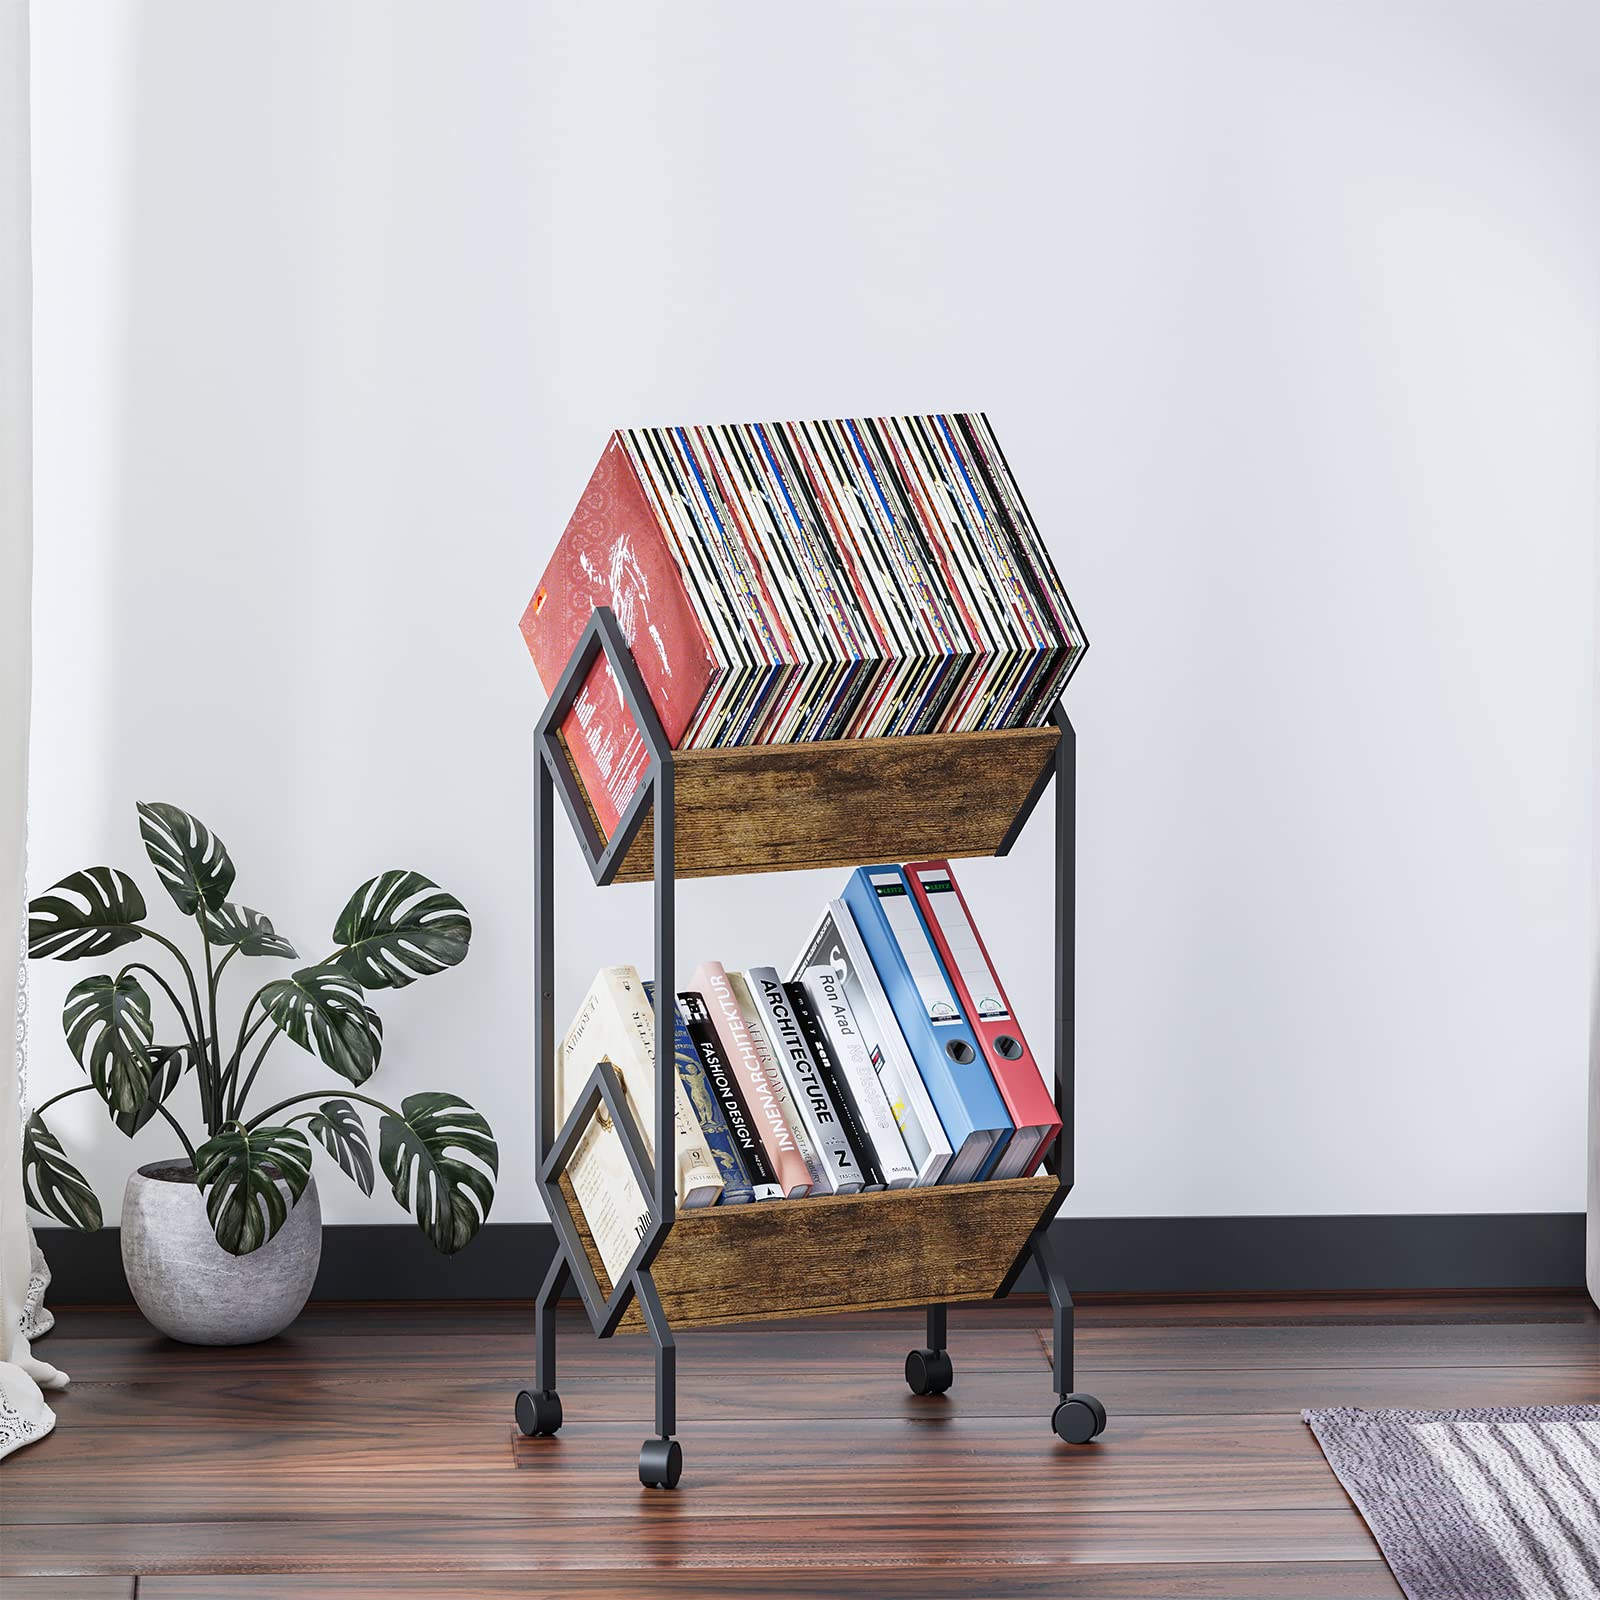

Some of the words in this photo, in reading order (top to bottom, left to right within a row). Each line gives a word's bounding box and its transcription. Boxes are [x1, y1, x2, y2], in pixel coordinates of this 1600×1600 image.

[633, 1012, 656, 1067] OTTER
[819, 974, 838, 1001] Ron
[832, 1004, 855, 1035] Arad
[710, 975, 795, 1151] INNENARCHITEKTUR
[746, 1020, 771, 1063] AFTER
[766, 1068, 787, 1103] DAYS
[760, 980, 834, 1125] ARCHITECTURE
[815, 1041, 831, 1068] zen
[700, 1042, 733, 1098] FASHION
[725, 1100, 755, 1149] DESIGN
[791, 1125, 806, 1148] SCOTT
[800, 1147, 821, 1183] MEDBURY
